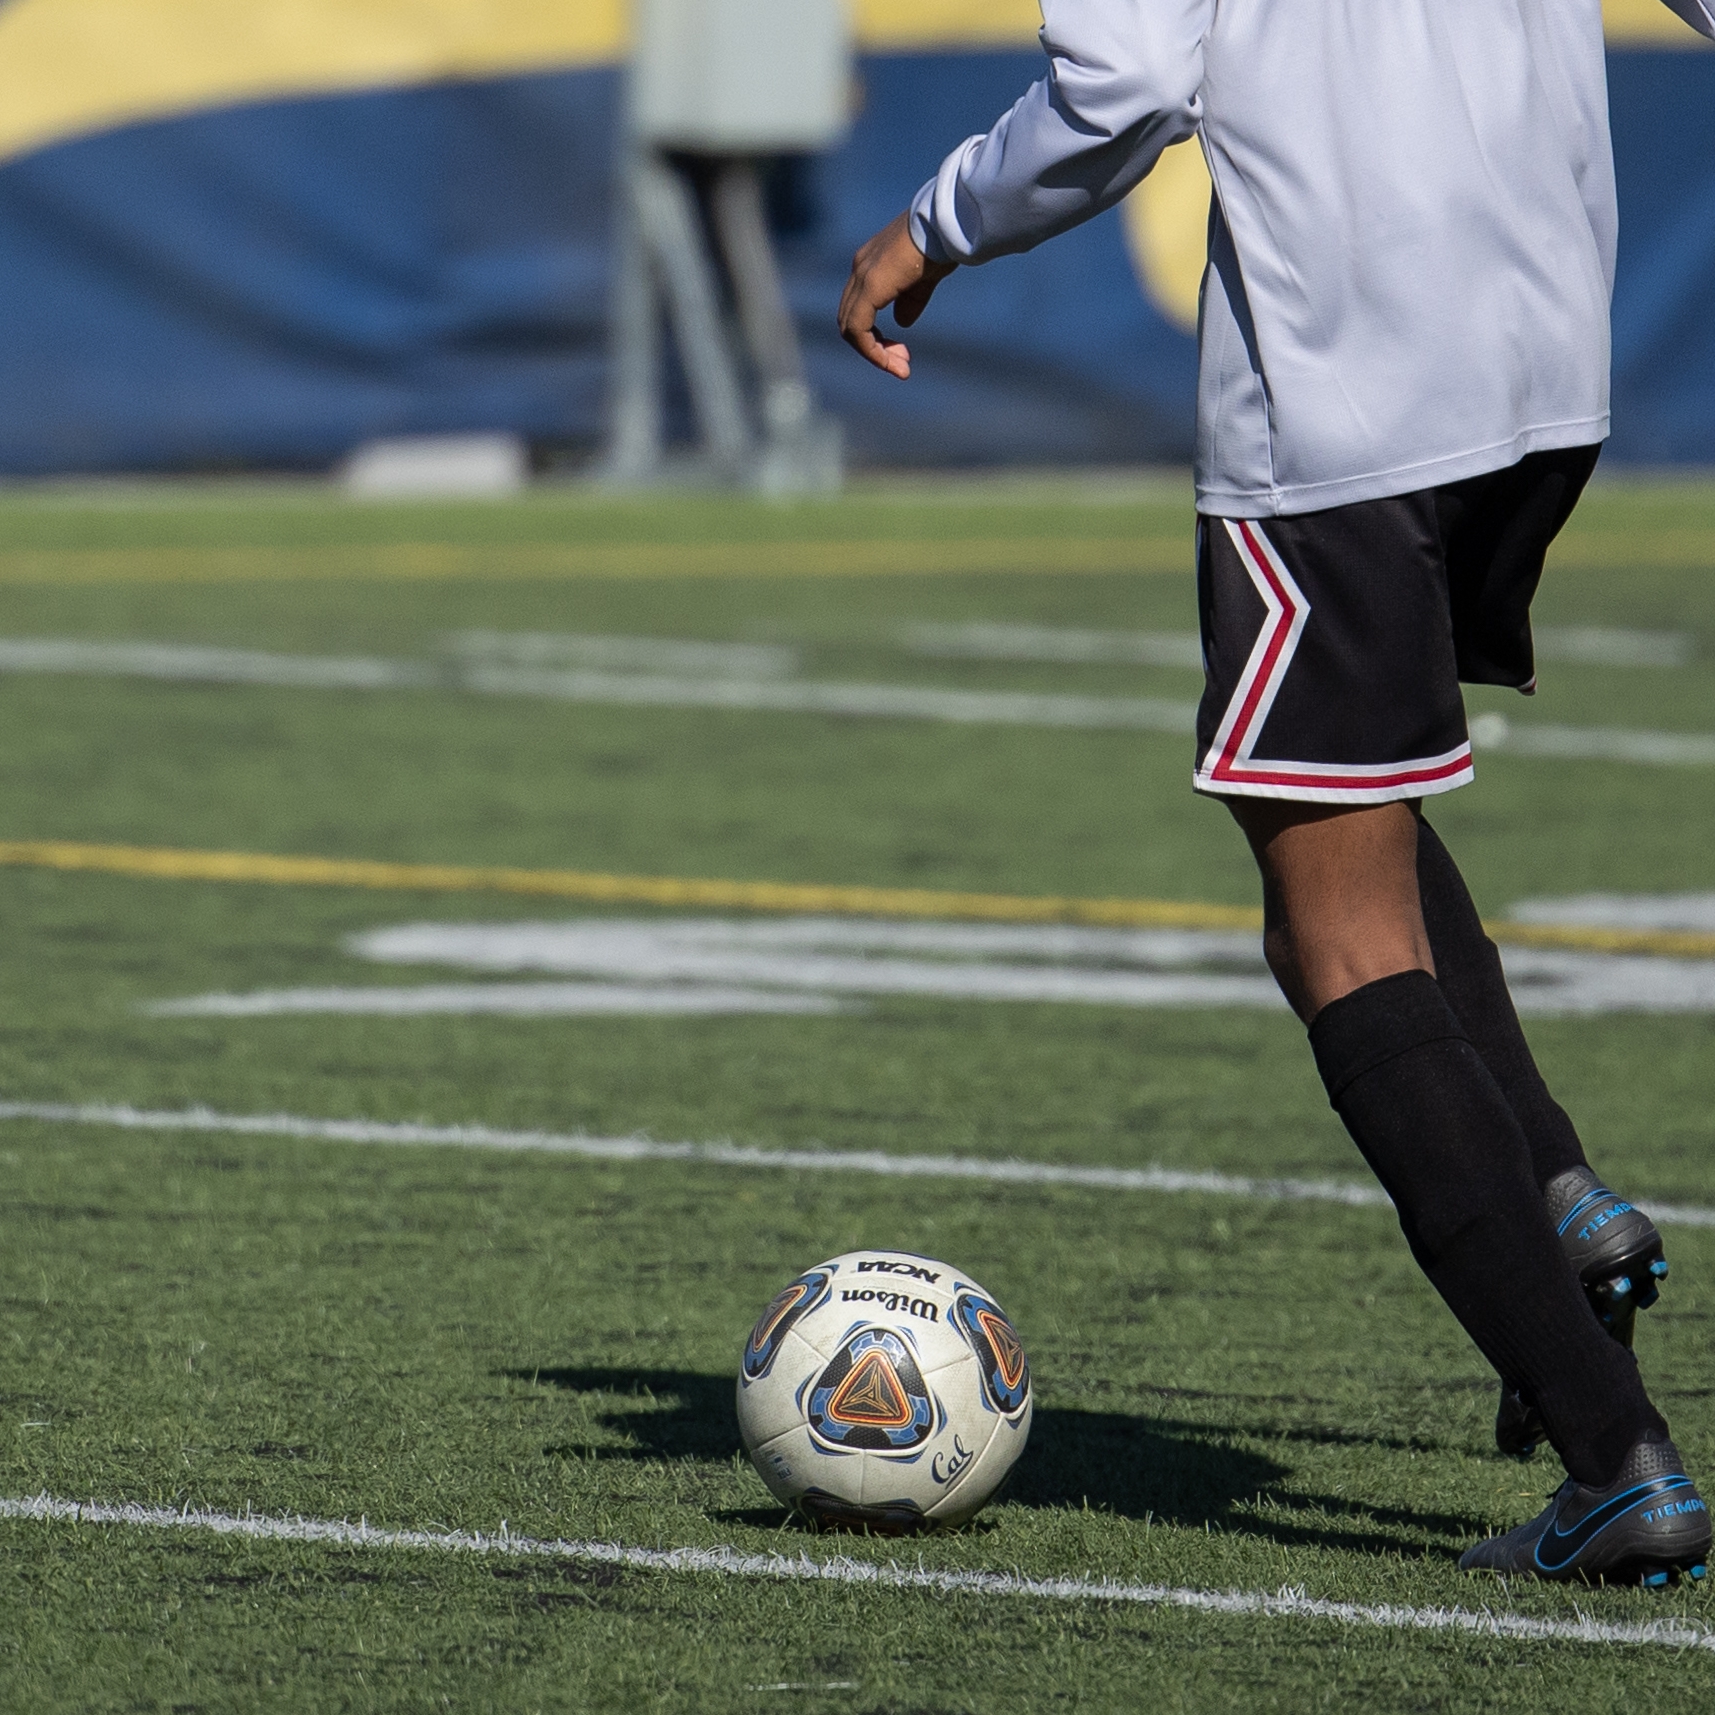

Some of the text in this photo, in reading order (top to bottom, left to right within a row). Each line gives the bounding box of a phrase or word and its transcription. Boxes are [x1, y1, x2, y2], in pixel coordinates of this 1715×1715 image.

[1578, 1202, 1636, 1240] TIEMP
[857, 1261, 942, 1284] NCAA
[841, 1289, 939, 1323] Wilson
[931, 1433, 974, 1489] Cal
